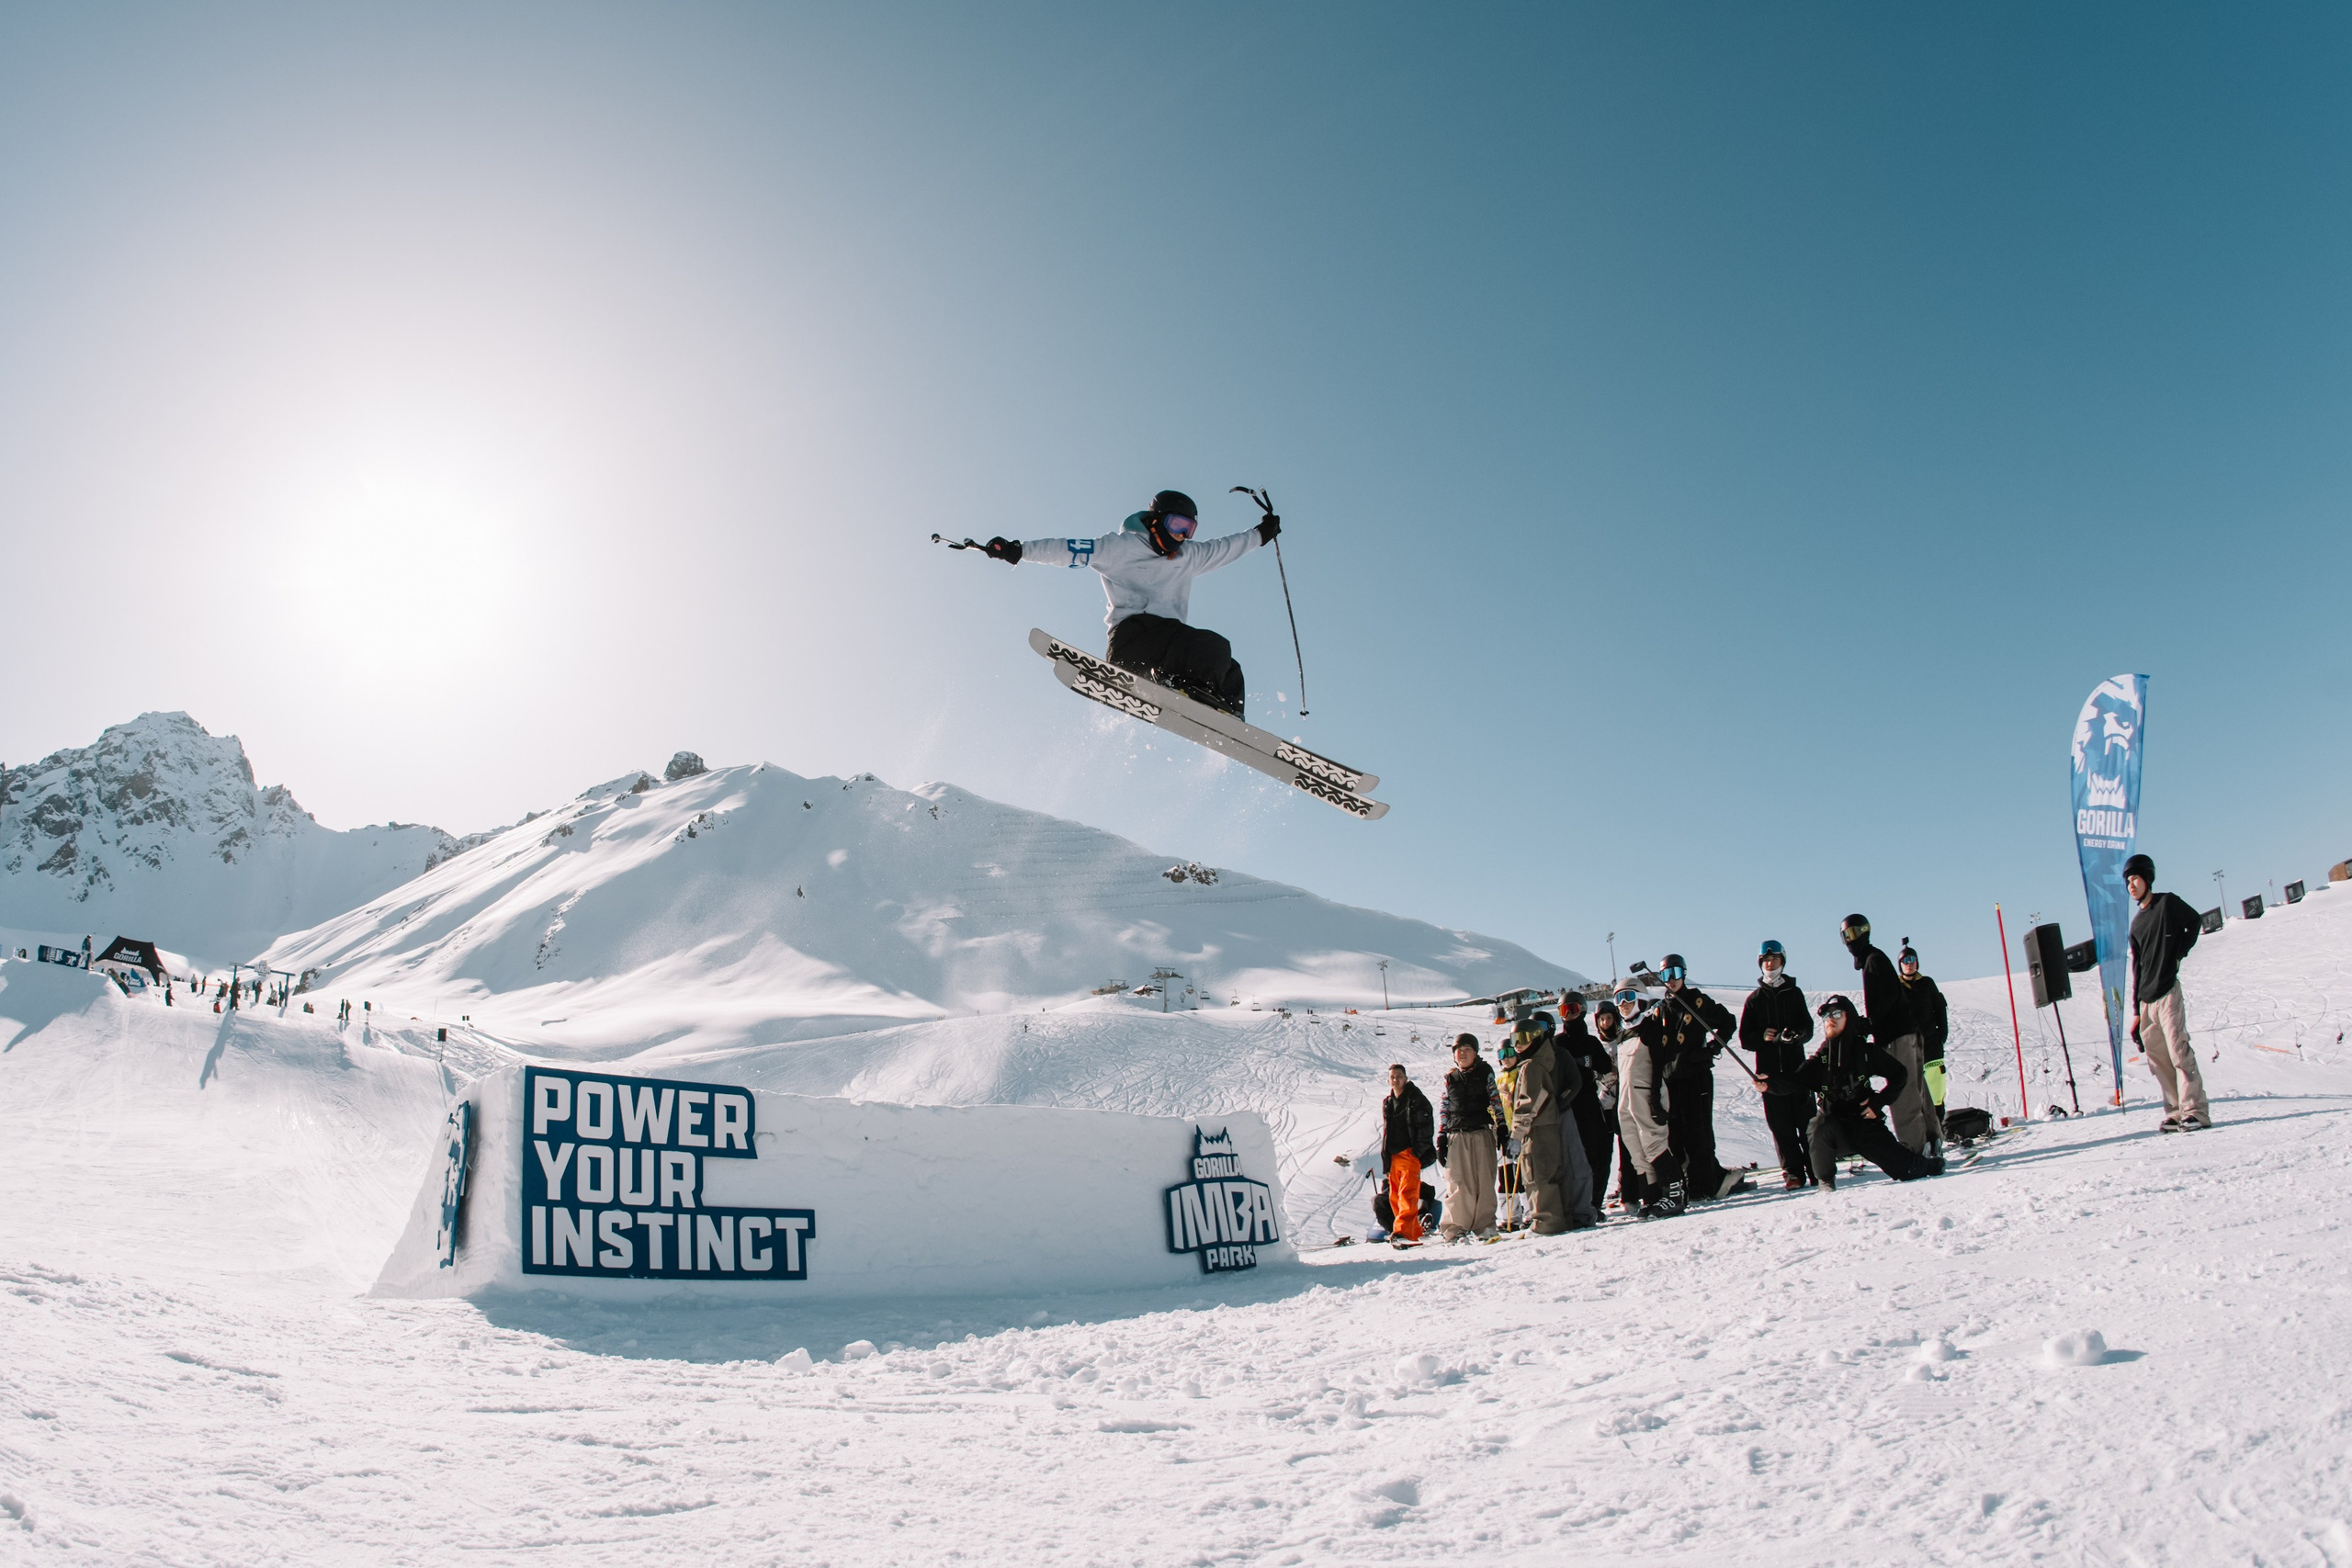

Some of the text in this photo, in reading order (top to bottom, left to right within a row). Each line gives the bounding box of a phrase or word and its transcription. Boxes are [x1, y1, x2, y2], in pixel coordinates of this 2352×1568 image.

[2076, 809, 2134, 838] GORILLA
[2084, 838, 2125, 850] ENERGY DRINK
[113, 952, 142, 964] GORILLA
[533, 1075, 749, 1150] POWER
[534, 1140, 696, 1208] YOUR
[1193, 1156, 1243, 1179] GORILLA
[1170, 1182, 1278, 1249] IMBA
[532, 1205, 808, 1272] INSTINCT
[1206, 1245, 1255, 1270] PARK
